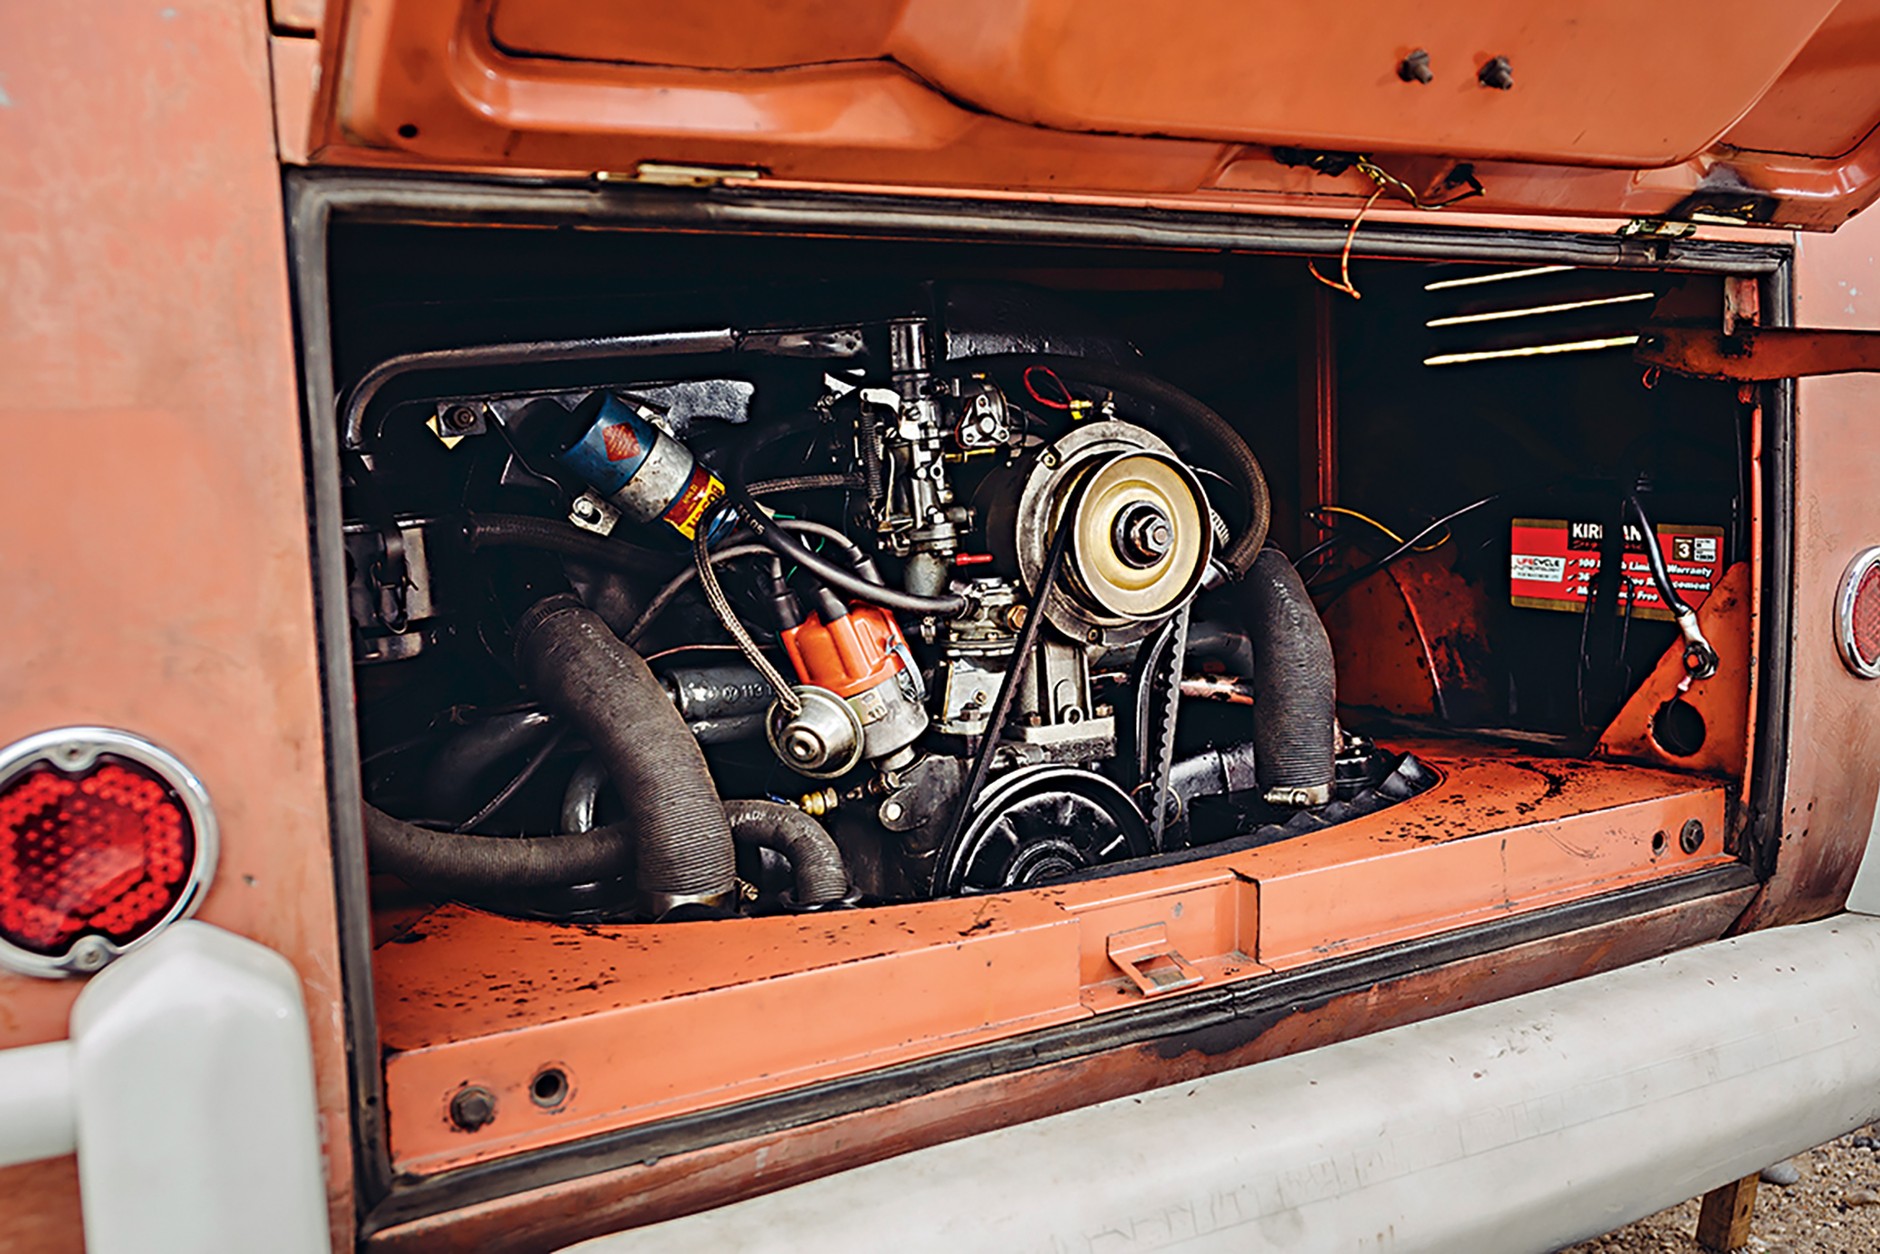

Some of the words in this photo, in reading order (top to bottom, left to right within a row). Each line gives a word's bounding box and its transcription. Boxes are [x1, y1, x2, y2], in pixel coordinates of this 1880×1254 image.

[1572, 523, 1642, 541] KIRAN
[1678, 543, 1690, 558] 3
[1578, 558, 1596, 568] 100
[1666, 564, 1712, 577] Warranty
[1645, 577, 1711, 591] Rcement
[1636, 590, 1659, 602] Free
